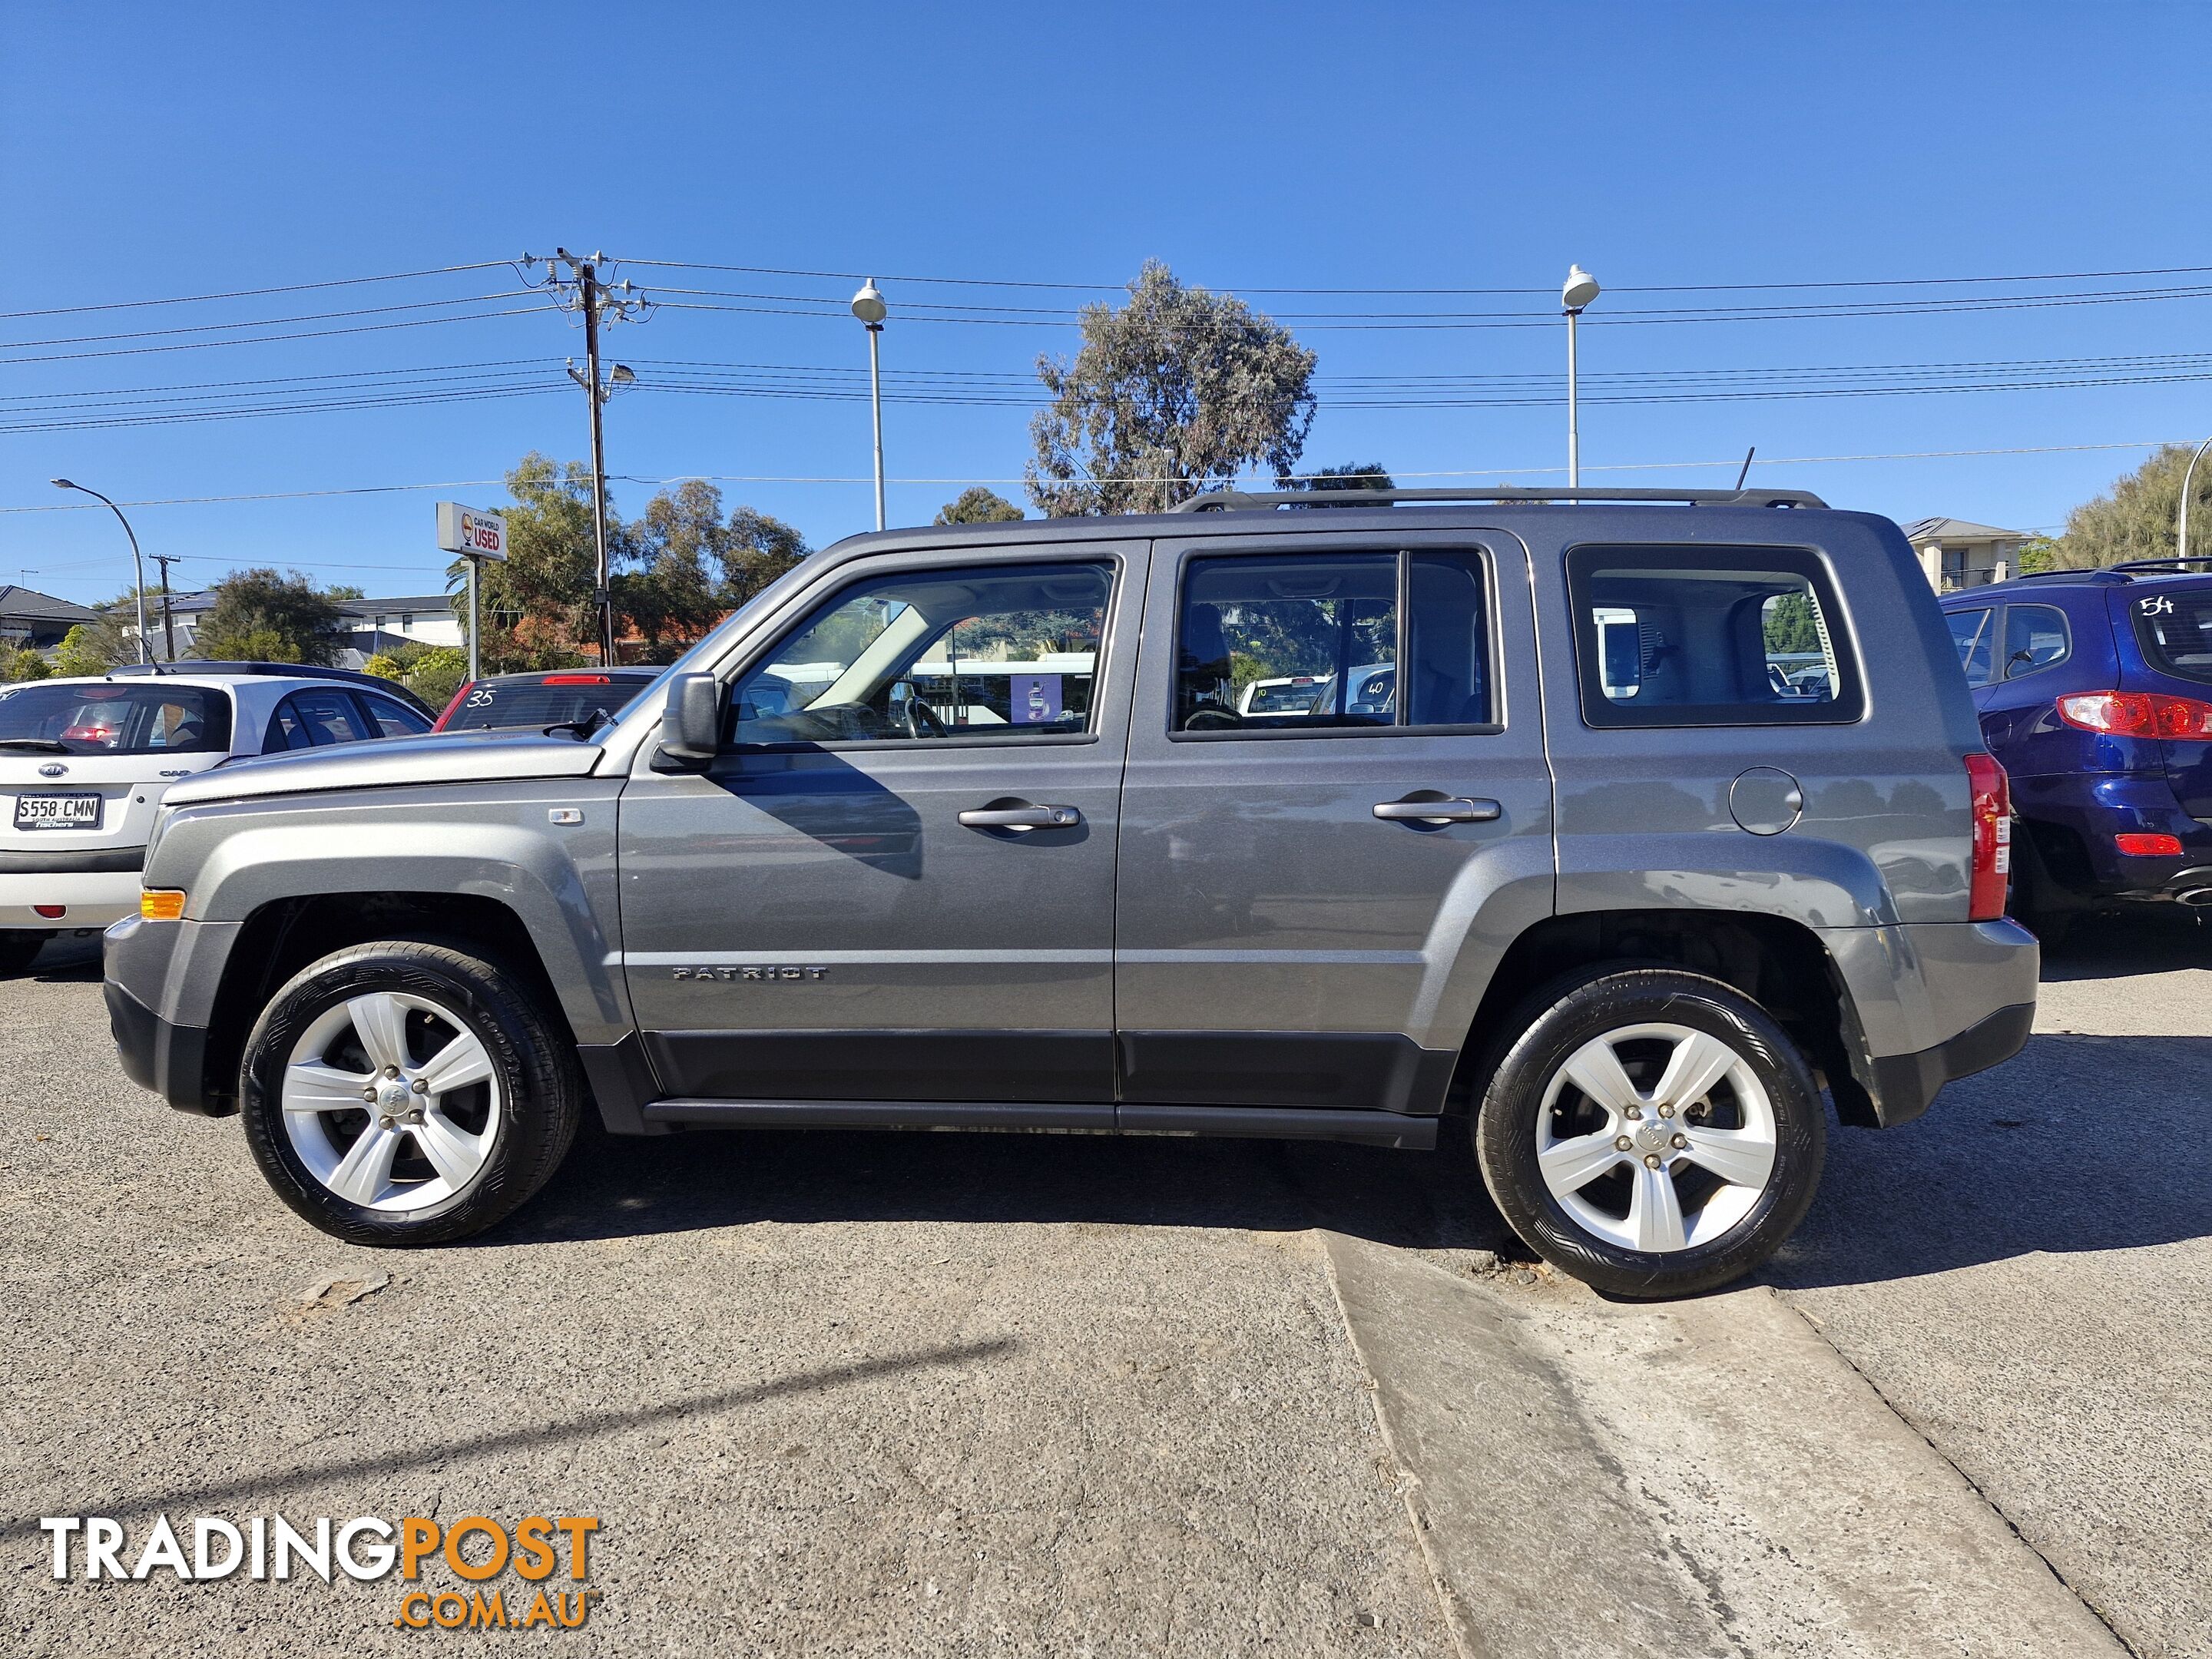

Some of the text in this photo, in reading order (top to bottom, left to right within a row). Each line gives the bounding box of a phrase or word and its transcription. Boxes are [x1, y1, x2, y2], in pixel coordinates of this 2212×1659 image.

[474, 517, 499, 531] CAR WORLD
[475, 528, 499, 551] USED
[2139, 595, 2174, 616] 54
[1368, 681, 1383, 695] 40
[466, 690, 498, 708] 35
[673, 967, 828, 980] PATRIOT
